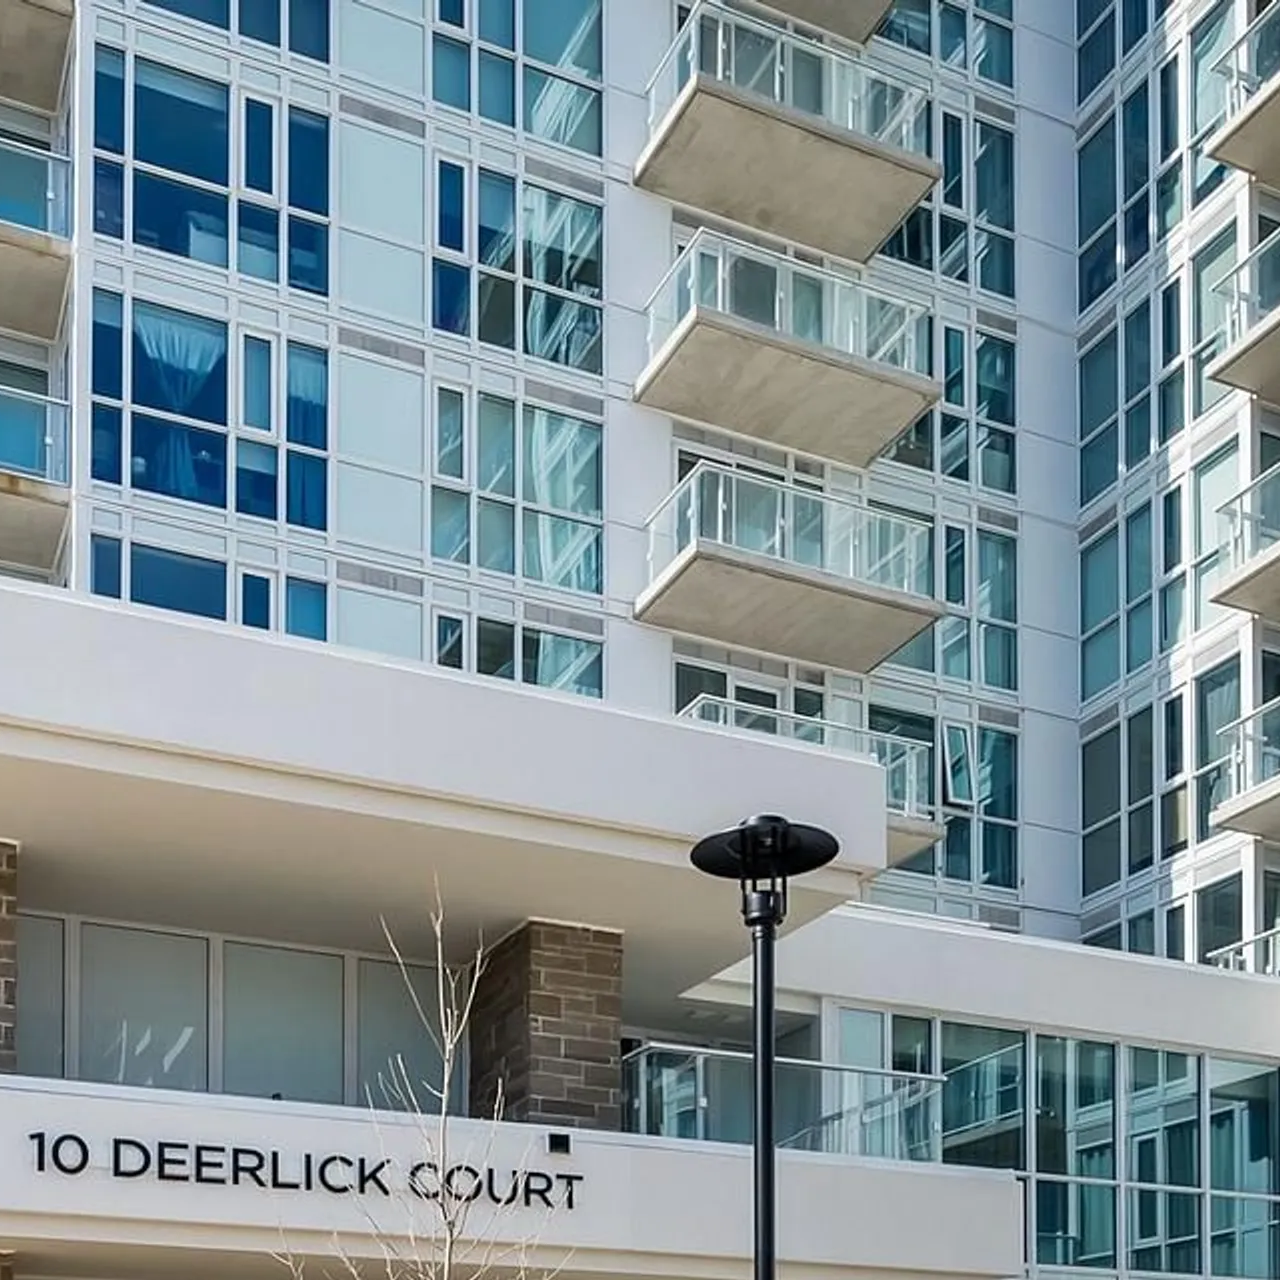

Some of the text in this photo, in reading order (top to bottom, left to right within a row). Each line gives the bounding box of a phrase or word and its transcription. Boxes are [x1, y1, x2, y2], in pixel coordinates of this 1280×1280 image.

[28, 1131, 584, 1210] 10 DEERLICK COURT
